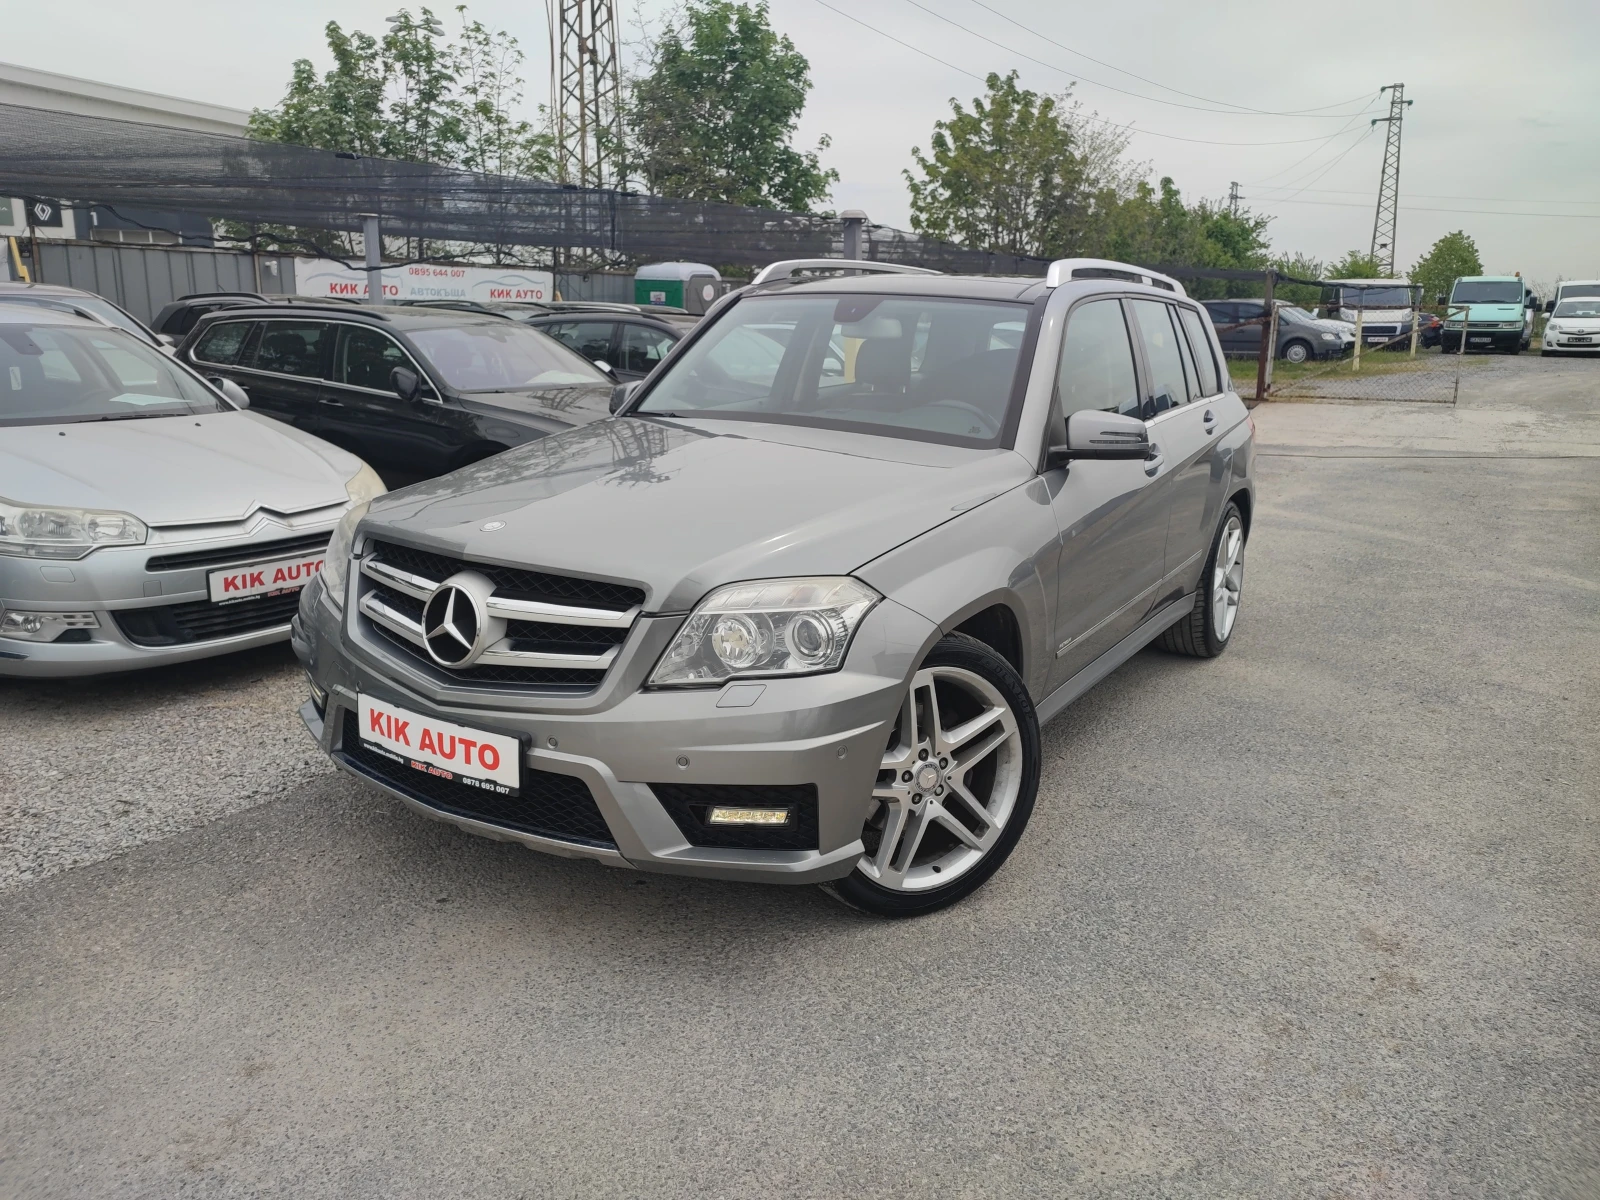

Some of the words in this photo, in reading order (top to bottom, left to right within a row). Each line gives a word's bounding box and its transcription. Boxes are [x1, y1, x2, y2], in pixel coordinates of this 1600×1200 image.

[409, 267, 431, 277] 0895
[433, 269, 448, 277] 644
[450, 269, 466, 278] 007
[329, 282, 358, 295] КИК
[363, 283, 399, 296] АТО
[490, 288, 512, 299] КИК
[515, 289, 543, 300] АУТО
[223, 570, 265, 592] KIK
[369, 708, 411, 747] KIK
[419, 727, 501, 771] AUTO
[410, 760, 427, 772] KIK
[428, 766, 453, 780] AUTO
[462, 777, 480, 787] 0878
[481, 783, 495, 791] 693
[496, 785, 510, 795] 007
